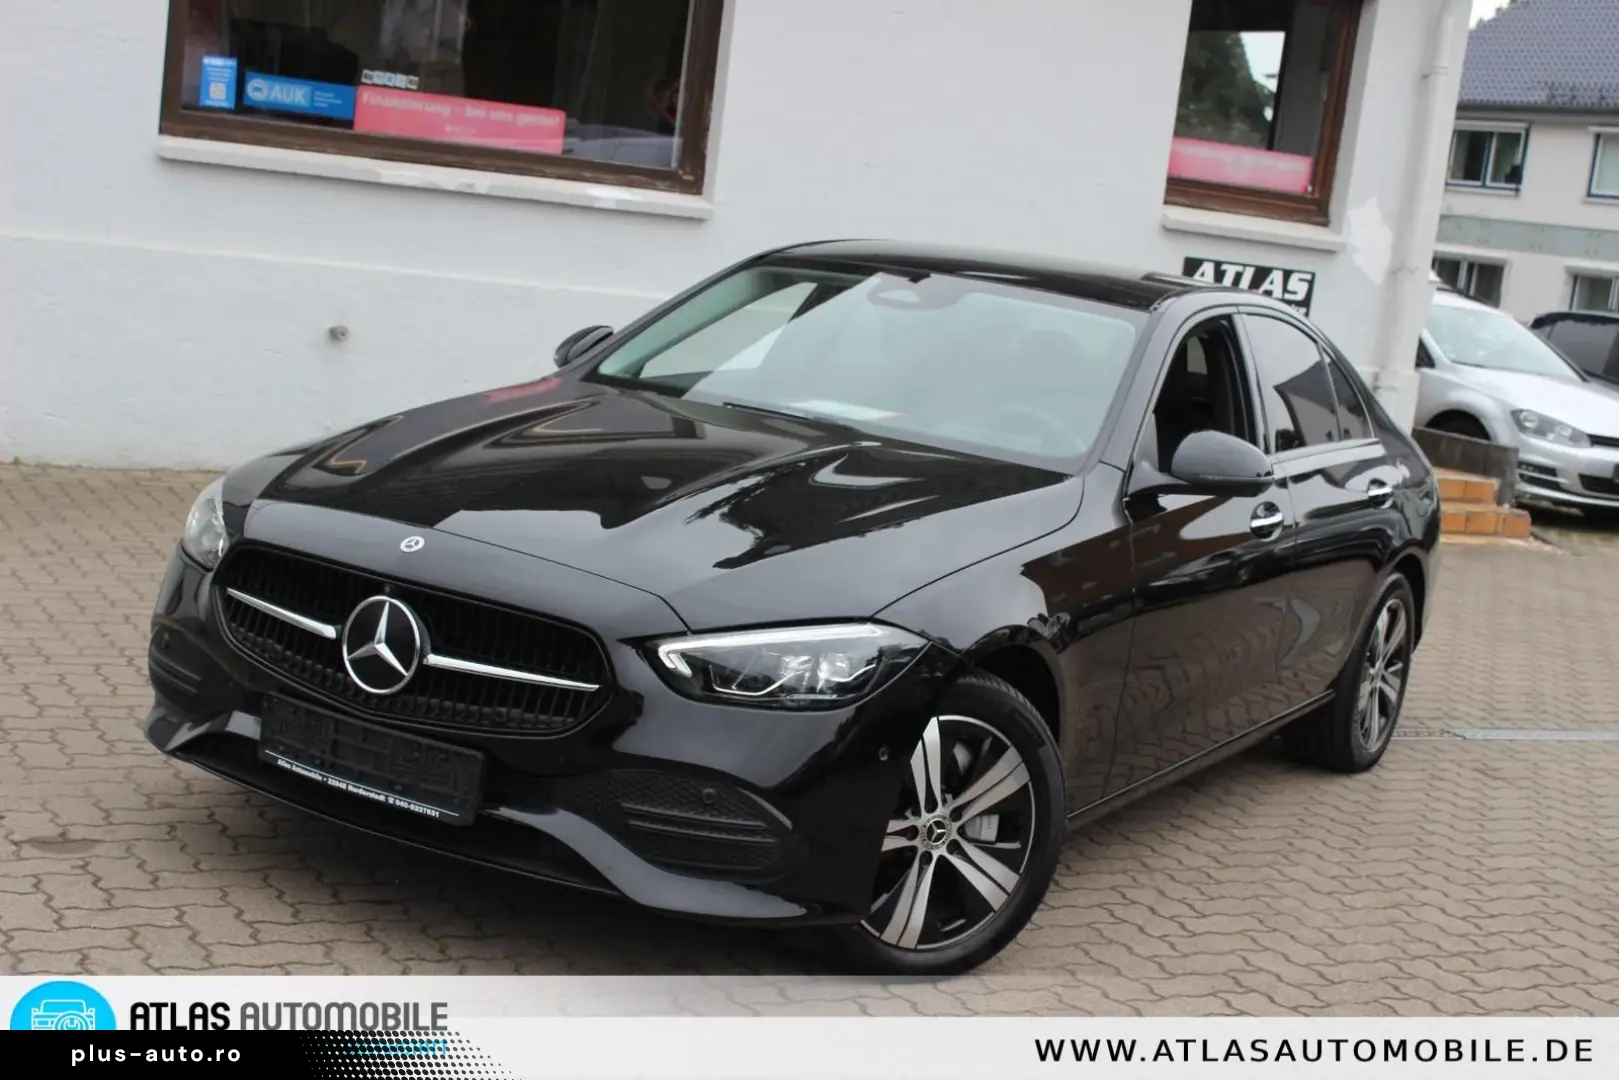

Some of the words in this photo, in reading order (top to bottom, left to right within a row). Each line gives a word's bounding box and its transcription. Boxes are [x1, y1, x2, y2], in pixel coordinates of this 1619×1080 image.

[270, 84, 305, 104] AUK
[465, 105, 487, 118] bei
[489, 110, 513, 122] uns
[1193, 261, 1313, 301] ATLAS
